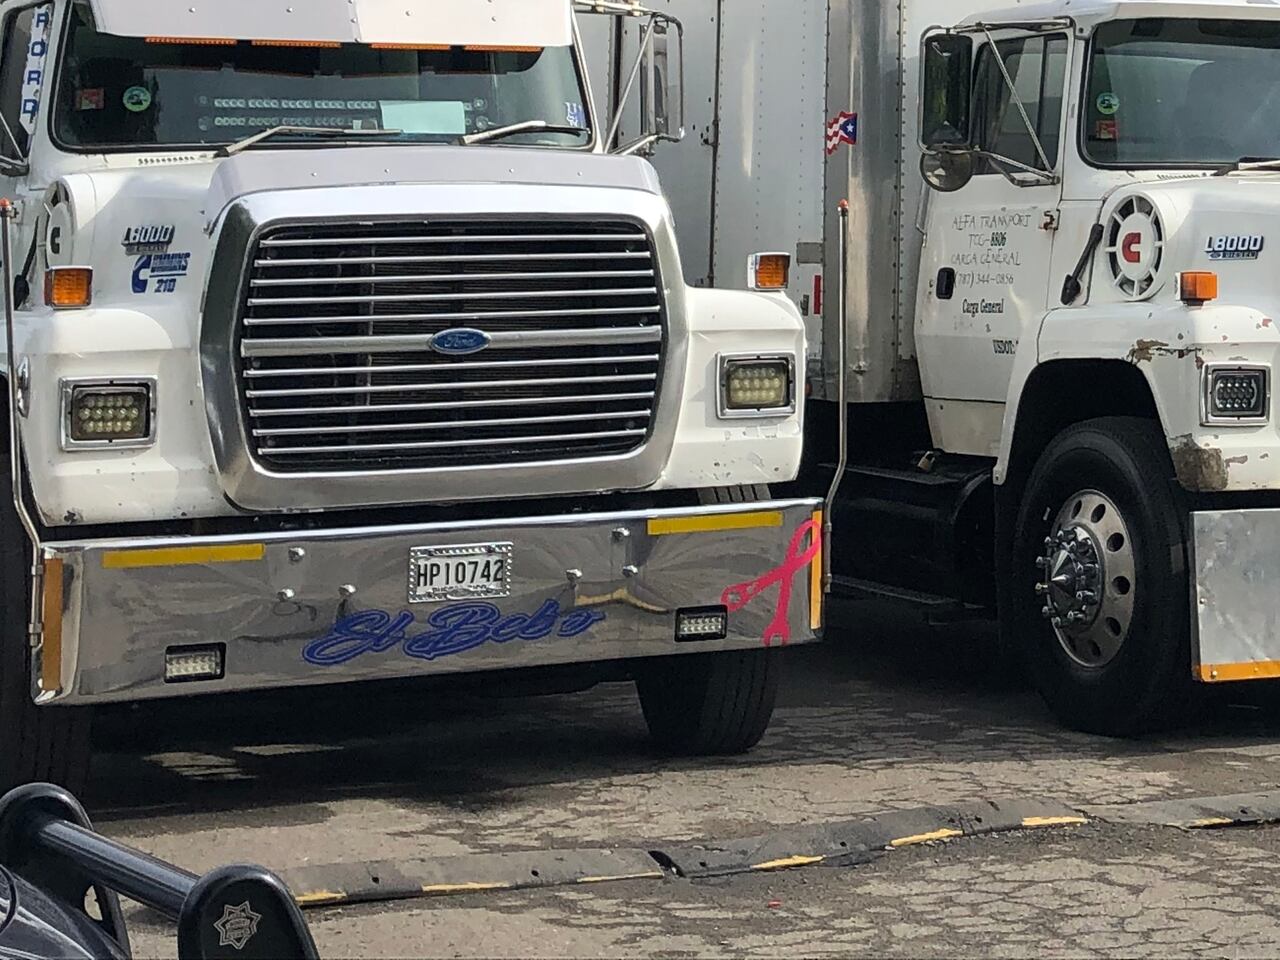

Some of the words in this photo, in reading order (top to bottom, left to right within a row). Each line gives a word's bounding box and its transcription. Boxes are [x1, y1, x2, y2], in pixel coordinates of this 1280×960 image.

[1204, 235, 1264, 252] L8000
[962, 298, 979, 318] Carga
[980, 298, 1004, 313] General
[417, 559, 504, 587] HP10742
